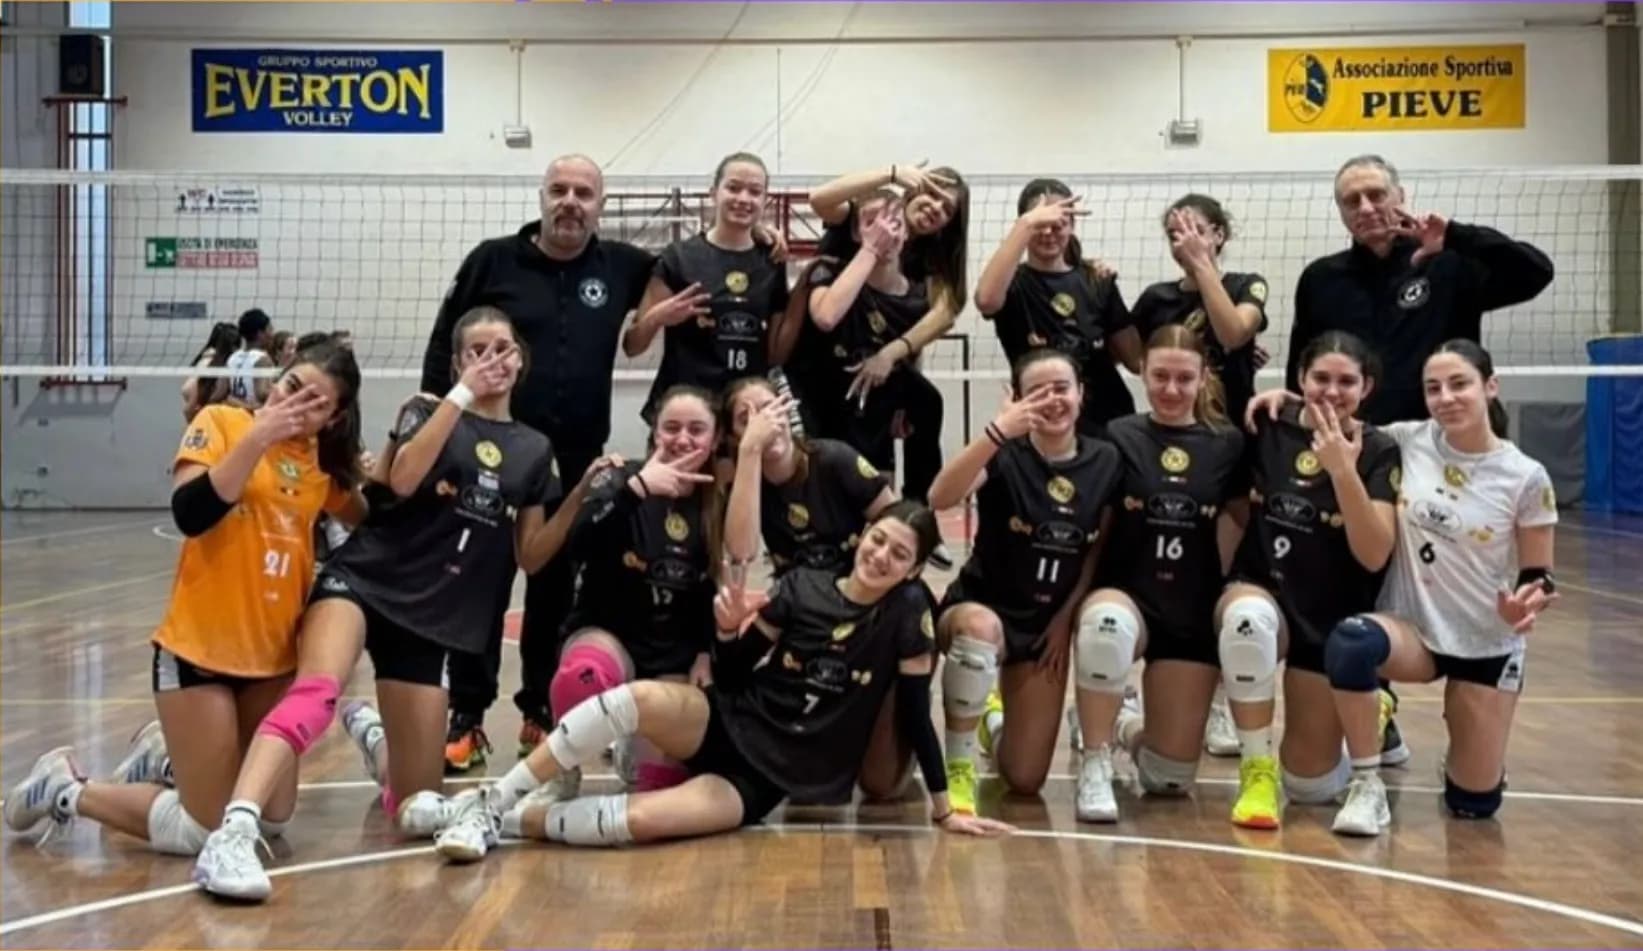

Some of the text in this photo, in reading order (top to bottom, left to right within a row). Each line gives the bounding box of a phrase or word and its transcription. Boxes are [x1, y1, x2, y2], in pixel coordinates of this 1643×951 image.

[257, 56, 378, 68] GRUPPO SPORTIVO
[1332, 55, 1513, 80] Associazione Sportiva
[204, 63, 431, 119] EVERTON
[1361, 90, 1483, 118] PIEVE
[283, 111, 354, 127] VOLLEY
[727, 348, 748, 370] 18
[457, 528, 471, 552] 1
[1156, 535, 1184, 560] 16
[1273, 535, 1291, 559] 9
[264, 550, 291, 578] 21
[1419, 541, 1436, 565] 6
[1037, 557, 1060, 583] 11
[803, 692, 820, 714] 7
